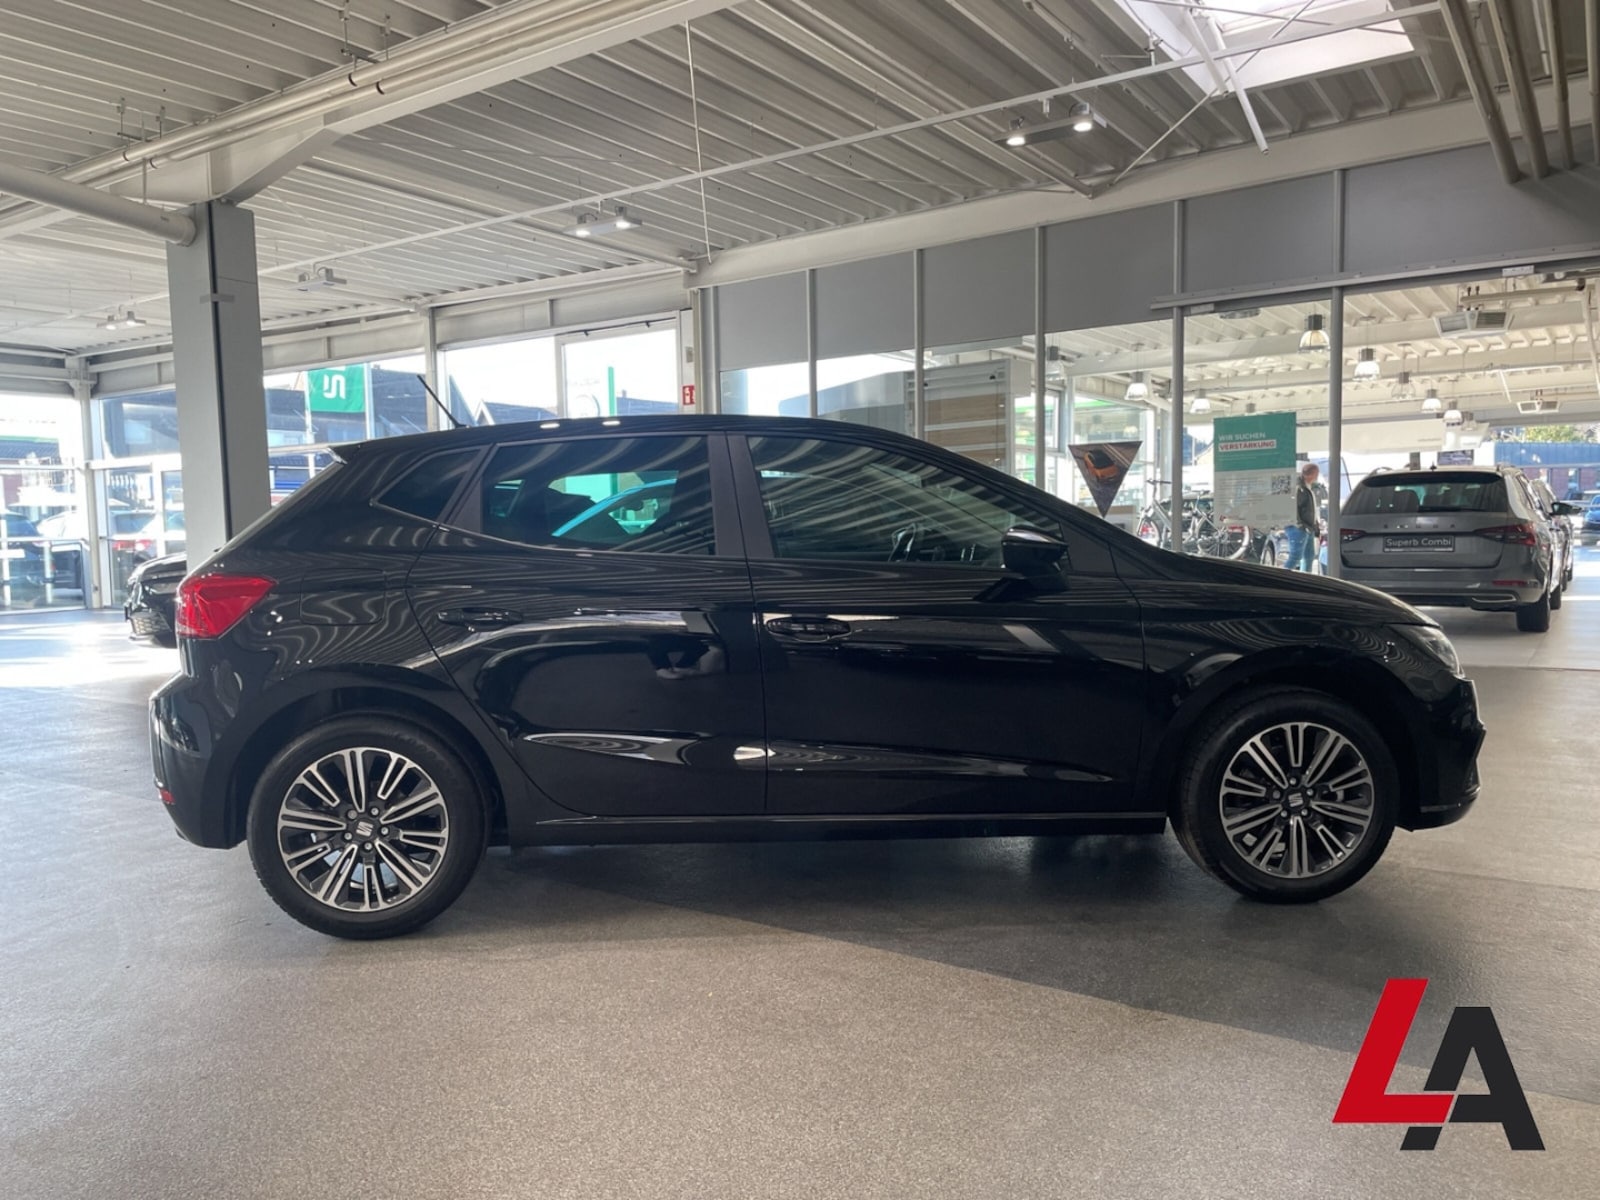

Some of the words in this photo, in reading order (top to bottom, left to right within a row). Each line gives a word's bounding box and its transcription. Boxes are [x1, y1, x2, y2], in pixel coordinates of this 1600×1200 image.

[1235, 432, 1266, 440] SUCHEN
[1386, 538, 1419, 547] Superb
[1421, 538, 1451, 546] Combi
